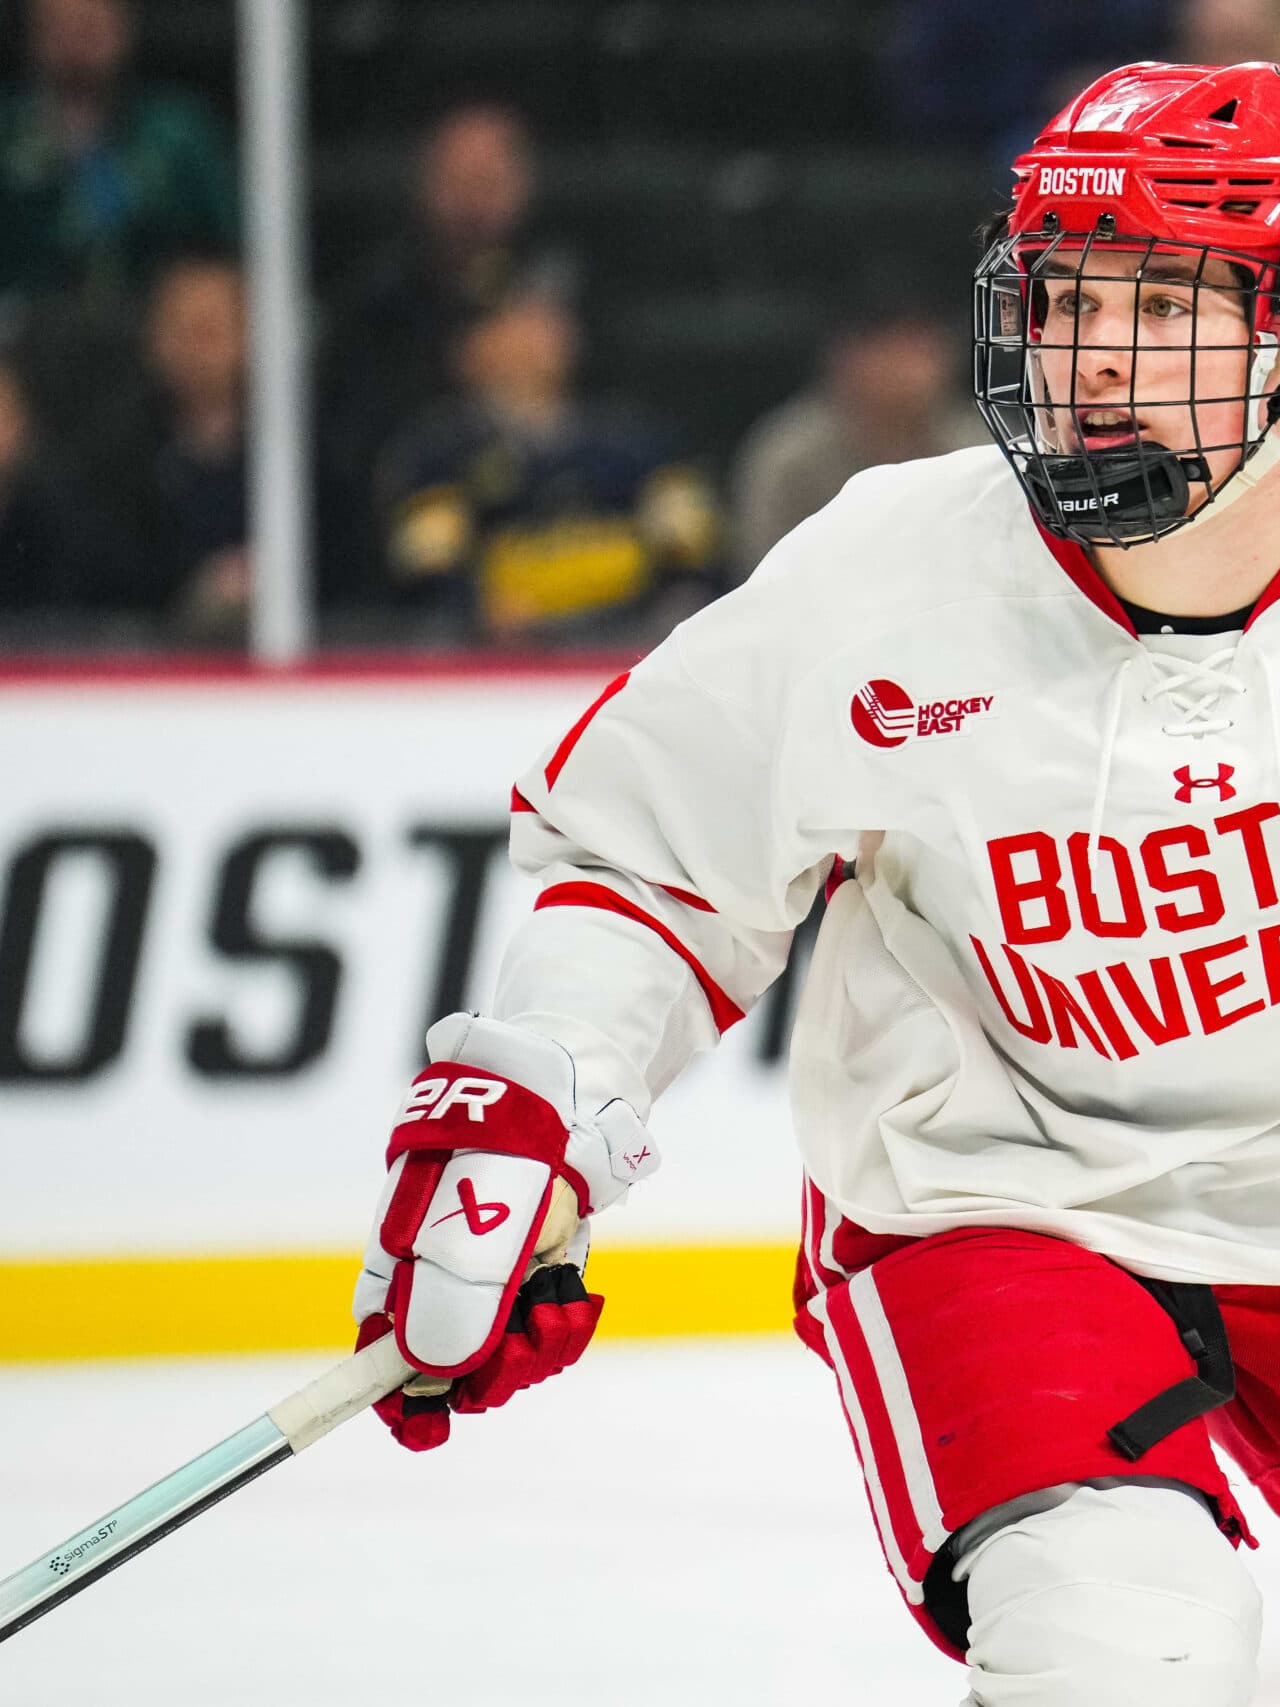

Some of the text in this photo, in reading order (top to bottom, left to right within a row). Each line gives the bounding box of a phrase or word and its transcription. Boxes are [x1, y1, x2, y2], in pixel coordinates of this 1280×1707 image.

[1038, 167, 1126, 196] BOSTON
[918, 696, 994, 721] HOCKEY
[917, 715, 965, 737] EAST
